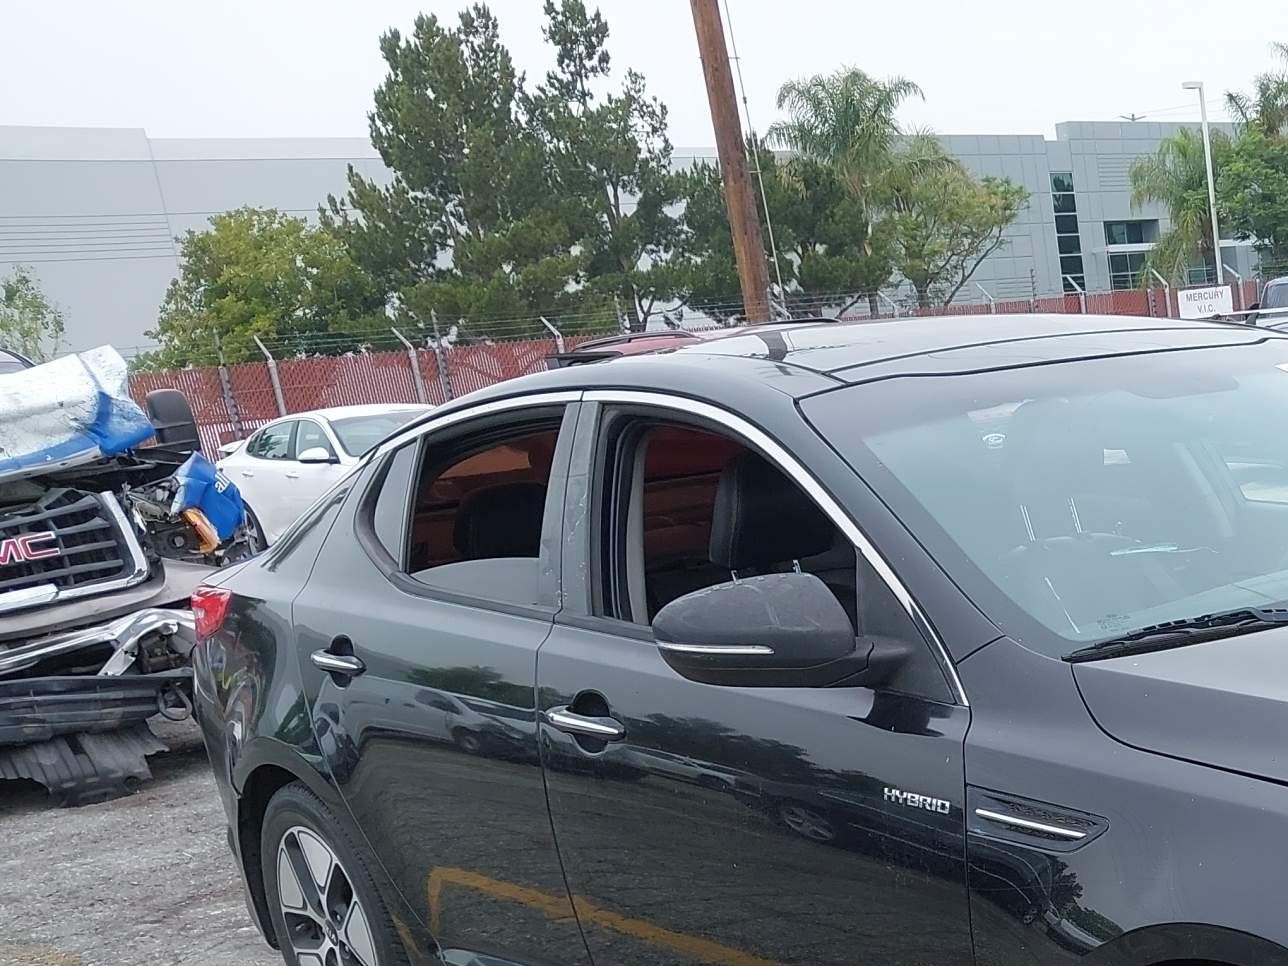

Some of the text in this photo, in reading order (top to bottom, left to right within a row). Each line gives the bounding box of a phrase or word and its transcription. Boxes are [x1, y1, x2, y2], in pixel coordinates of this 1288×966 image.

[1185, 289, 1224, 302] MERCURY
[0, 531, 61, 565] MC
[883, 787, 950, 815] HYBRID
